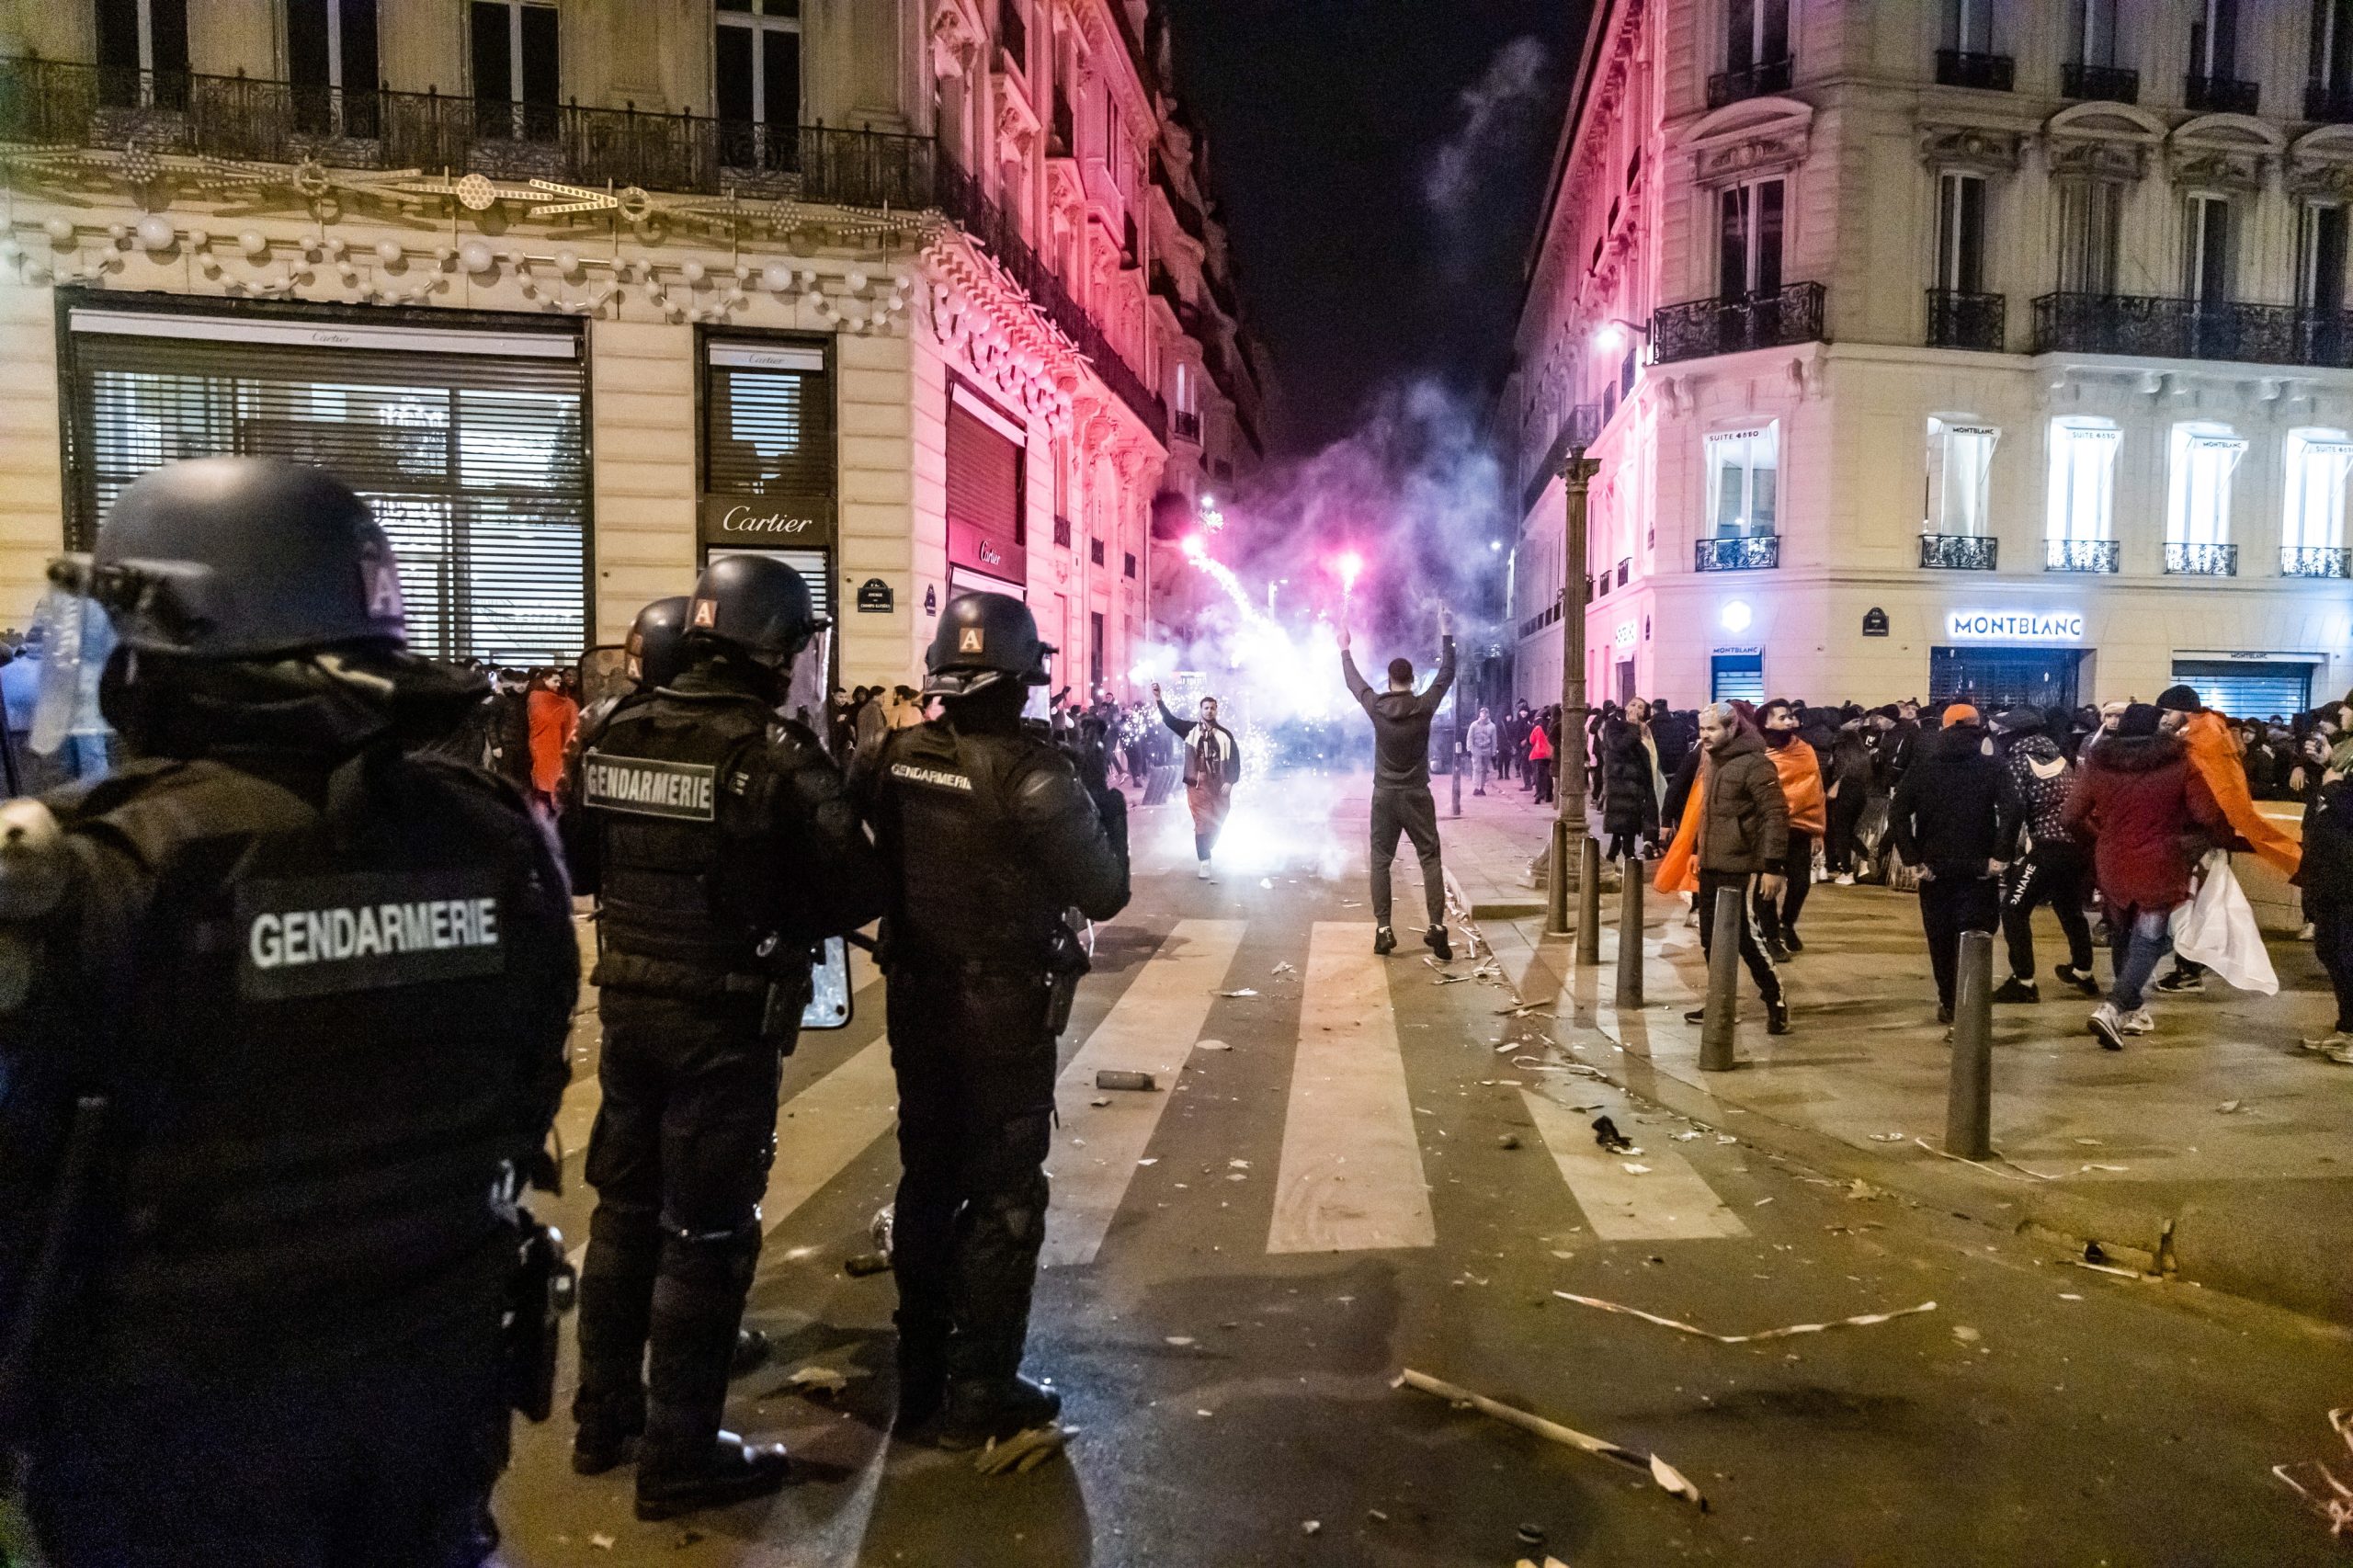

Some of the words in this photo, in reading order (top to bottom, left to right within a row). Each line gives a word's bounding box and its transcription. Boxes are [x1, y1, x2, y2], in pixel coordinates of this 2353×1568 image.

[748, 354, 785, 364] Cartier
[1710, 433, 1733, 441] SUITE
[722, 506, 813, 533] Cartier
[980, 540, 1001, 566] Cartier
[694, 601, 713, 625] A
[1954, 617, 2081, 635] MONTBLANC
[960, 629, 983, 650] A
[628, 658, 642, 678] A
[587, 764, 710, 809] GENDARMERIE
[250, 897, 498, 968] GENDARMERIE
